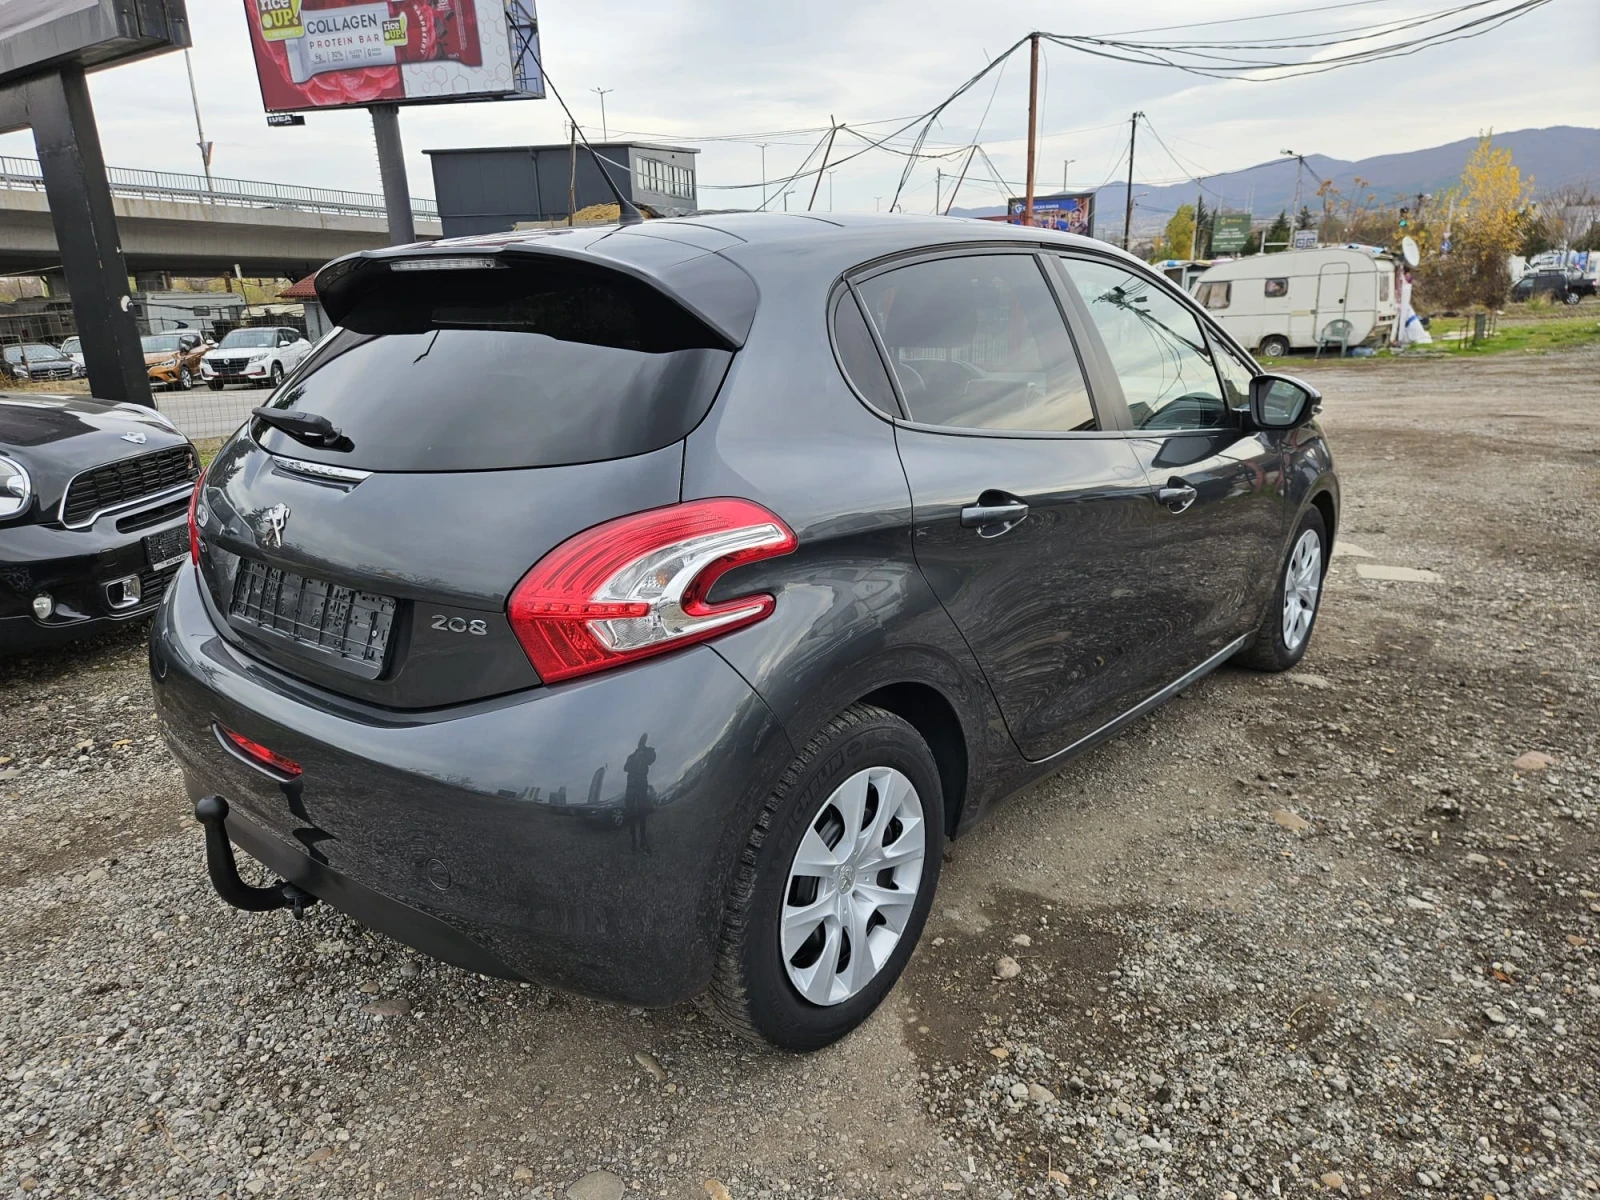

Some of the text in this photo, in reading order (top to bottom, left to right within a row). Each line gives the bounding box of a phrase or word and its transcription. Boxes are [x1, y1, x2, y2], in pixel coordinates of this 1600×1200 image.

[306, 13, 378, 35] COLLAGEN
[383, 21, 400, 31] rice
[309, 33, 381, 50] PROTEIN BAR
[431, 614, 488, 636] 208
